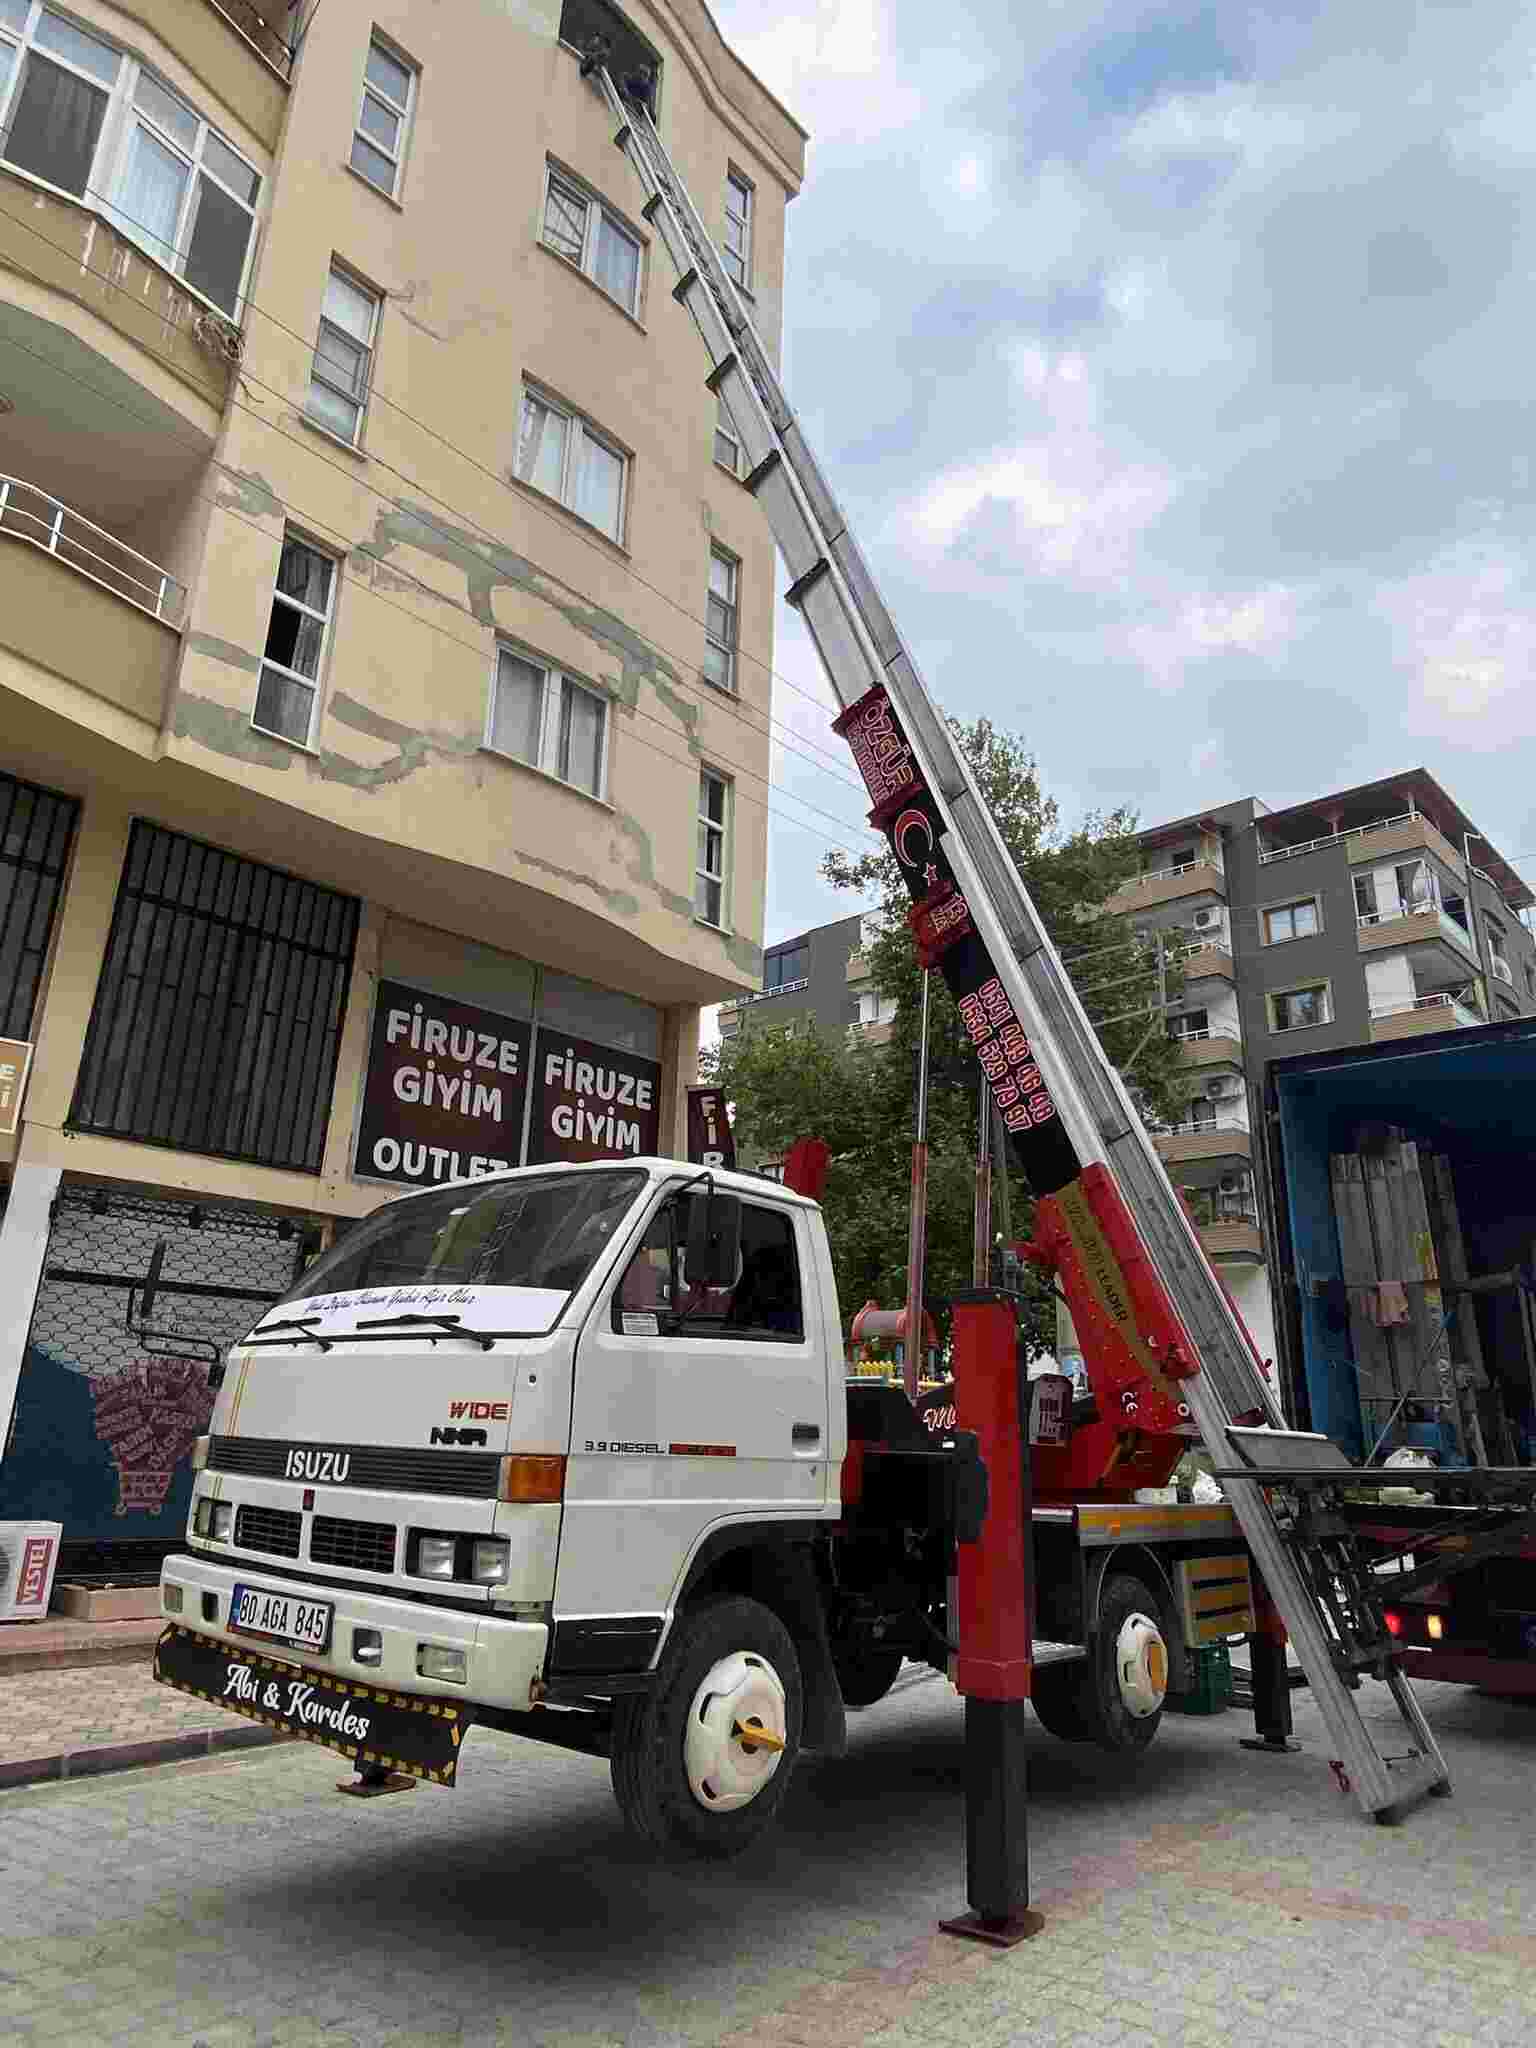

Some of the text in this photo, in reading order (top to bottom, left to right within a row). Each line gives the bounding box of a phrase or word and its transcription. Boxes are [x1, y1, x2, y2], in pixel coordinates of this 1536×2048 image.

[386, 1002, 520, 1075] FİRUZE
[392, 1060, 503, 1121] GİYİM
[544, 1048, 652, 1111] FİRUZE
[551, 1098, 640, 1153] GİYİM
[1005, 1104, 1032, 1134] 97
[448, 1402, 509, 1420] WIDE
[285, 1449, 351, 1482] ISUZU
[610, 1442, 665, 1454] DIESEL
[240, 1593, 326, 1639] 80 AGA 845
[223, 1663, 370, 1740] Abi & Kardes
